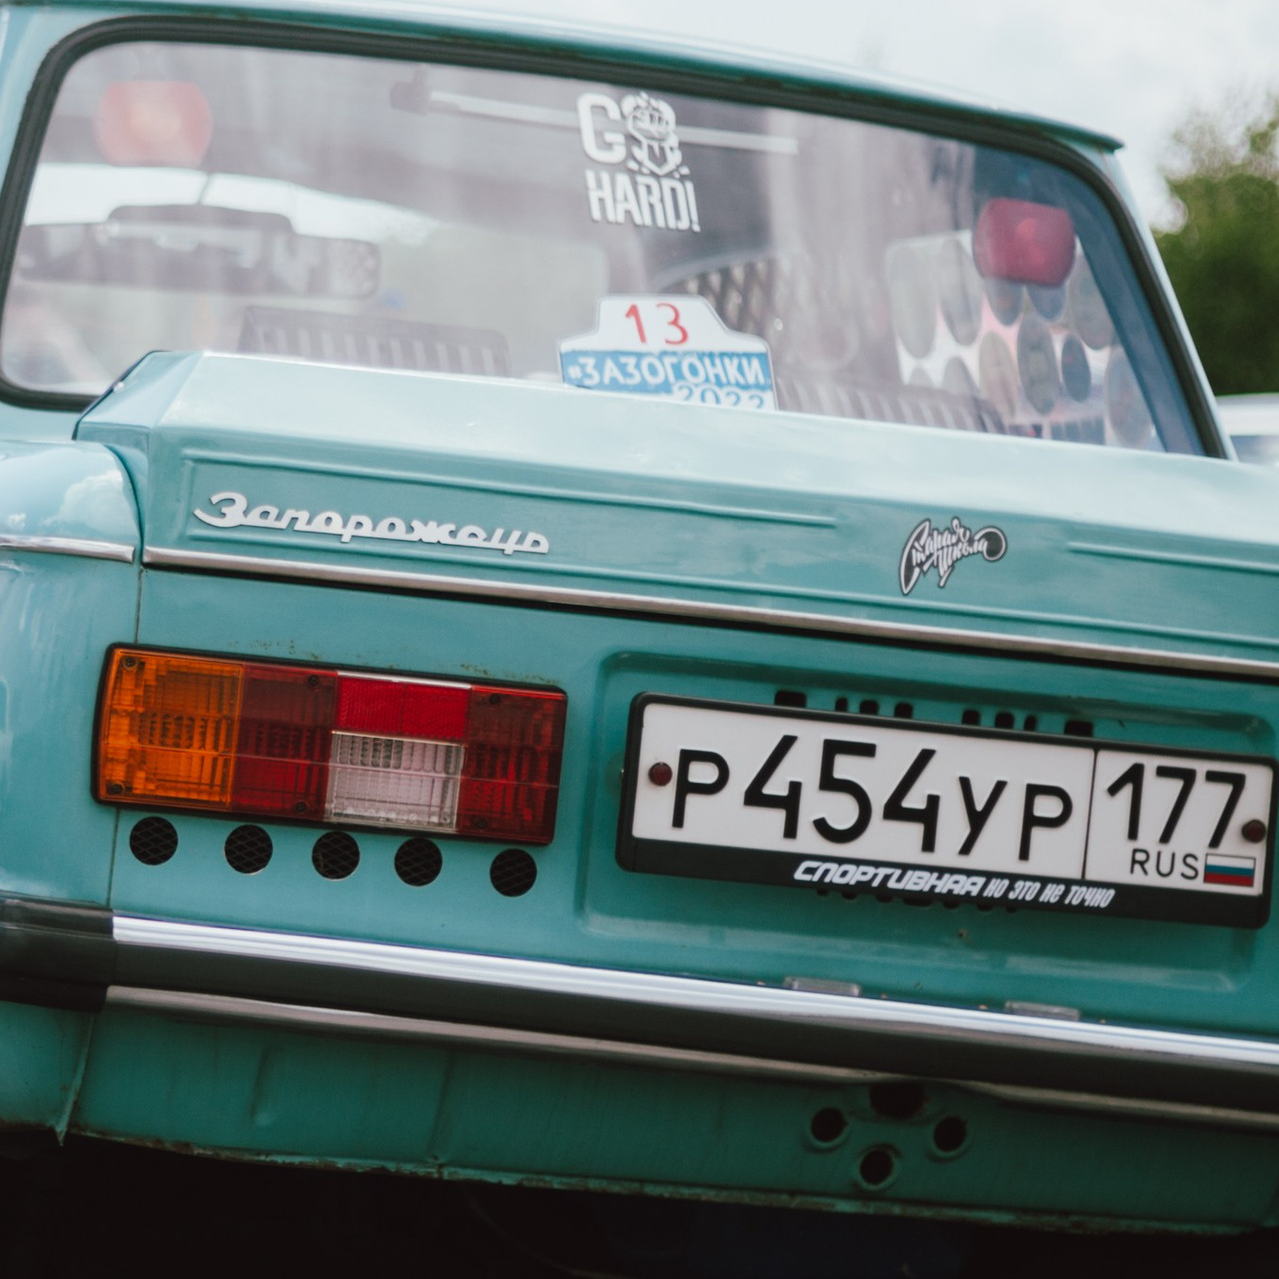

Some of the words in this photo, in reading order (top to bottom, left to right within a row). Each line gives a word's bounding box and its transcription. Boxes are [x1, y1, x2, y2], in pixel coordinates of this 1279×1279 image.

[585, 169, 700, 232] HARD!
[625, 303, 689, 345] 13
[1106, 762, 1247, 849] 177
[793, 860, 986, 898] СПОРТИВНАЯ
[1130, 848, 1199, 880] RUS
